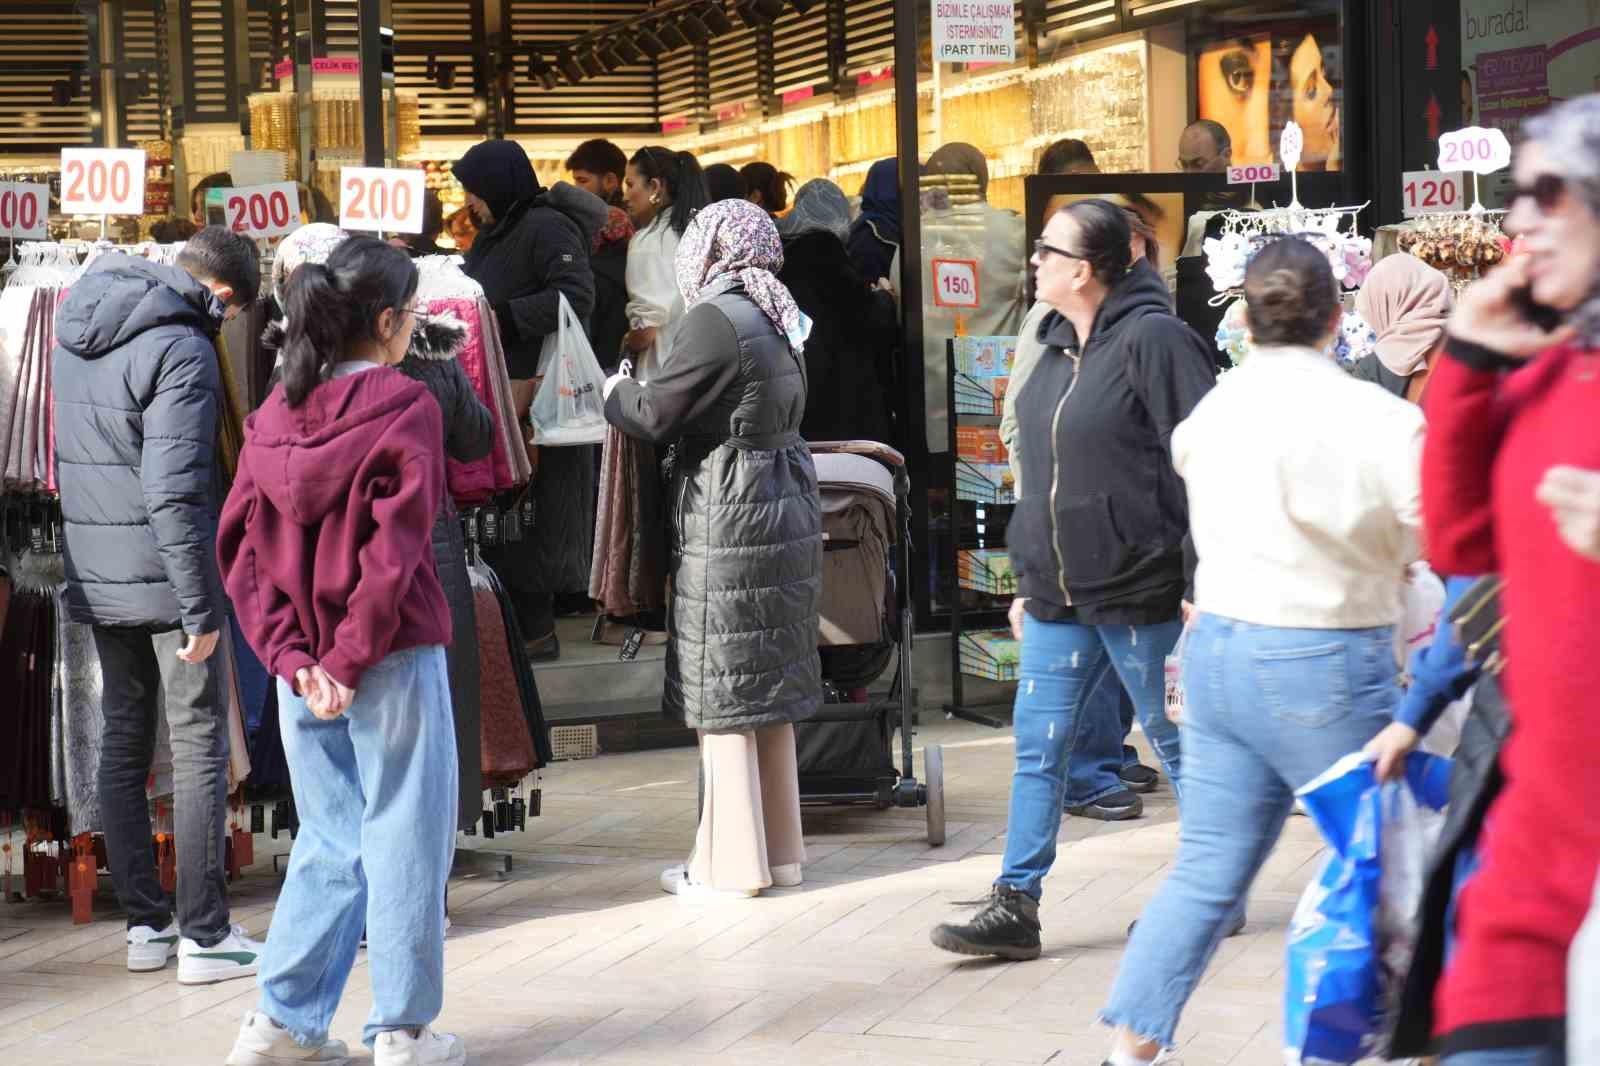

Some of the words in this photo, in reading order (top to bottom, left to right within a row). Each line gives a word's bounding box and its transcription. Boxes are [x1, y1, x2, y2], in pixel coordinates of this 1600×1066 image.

[1465, 4, 1528, 40] burada!
[941, 44, 976, 57] (PART
[1444, 137, 1492, 163] 200
[65, 159, 131, 204] 200
[1232, 167, 1273, 182] 300
[345, 177, 411, 222] 200
[1404, 179, 1457, 208] 120
[228, 190, 290, 234] 200
[943, 275, 970, 295] 150
